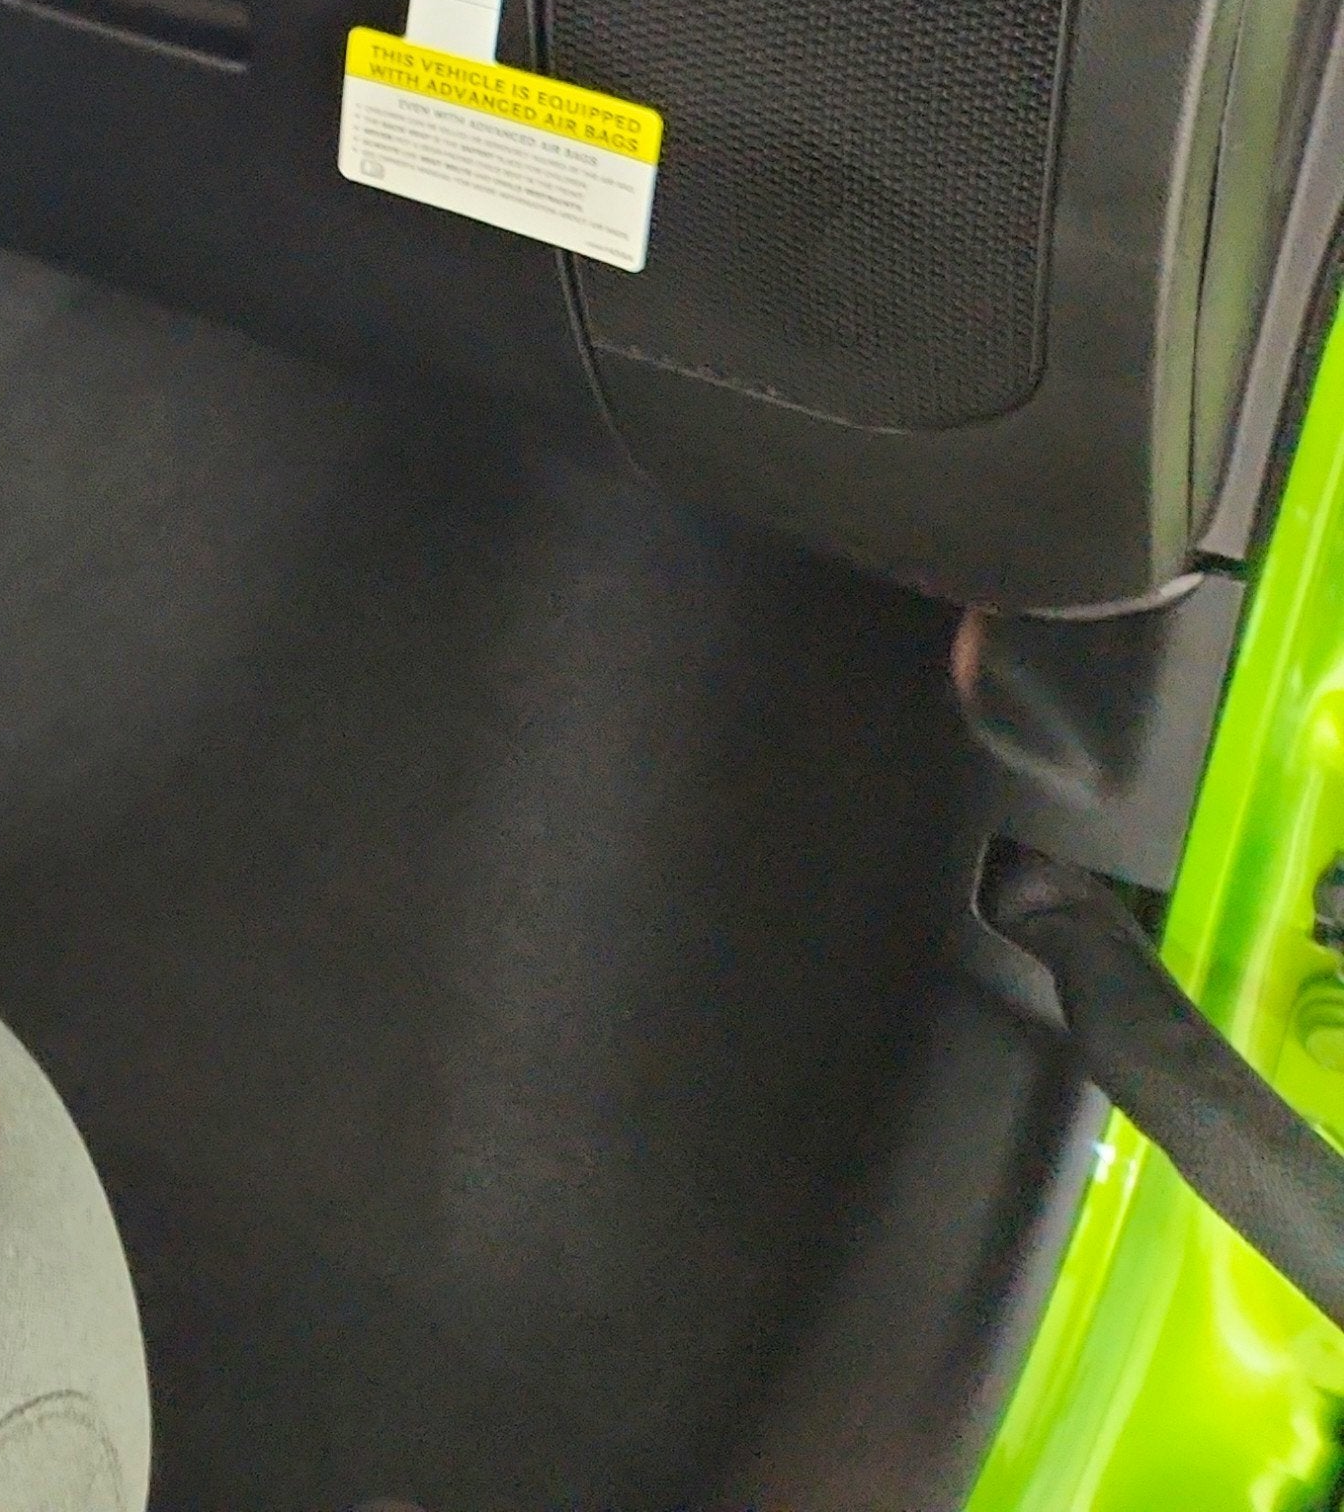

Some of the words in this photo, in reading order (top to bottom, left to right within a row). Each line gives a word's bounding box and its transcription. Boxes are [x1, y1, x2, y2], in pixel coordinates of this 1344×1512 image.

[369, 62, 419, 88] WITH
[426, 79, 537, 121] ADVANCED
[544, 113, 577, 134] AIR
[584, 124, 640, 153] BAGS
[372, 45, 414, 67] THIS
[421, 58, 506, 93] VEHICLE
[512, 84, 530, 101] IS
[537, 91, 642, 134] EQUIPPED
